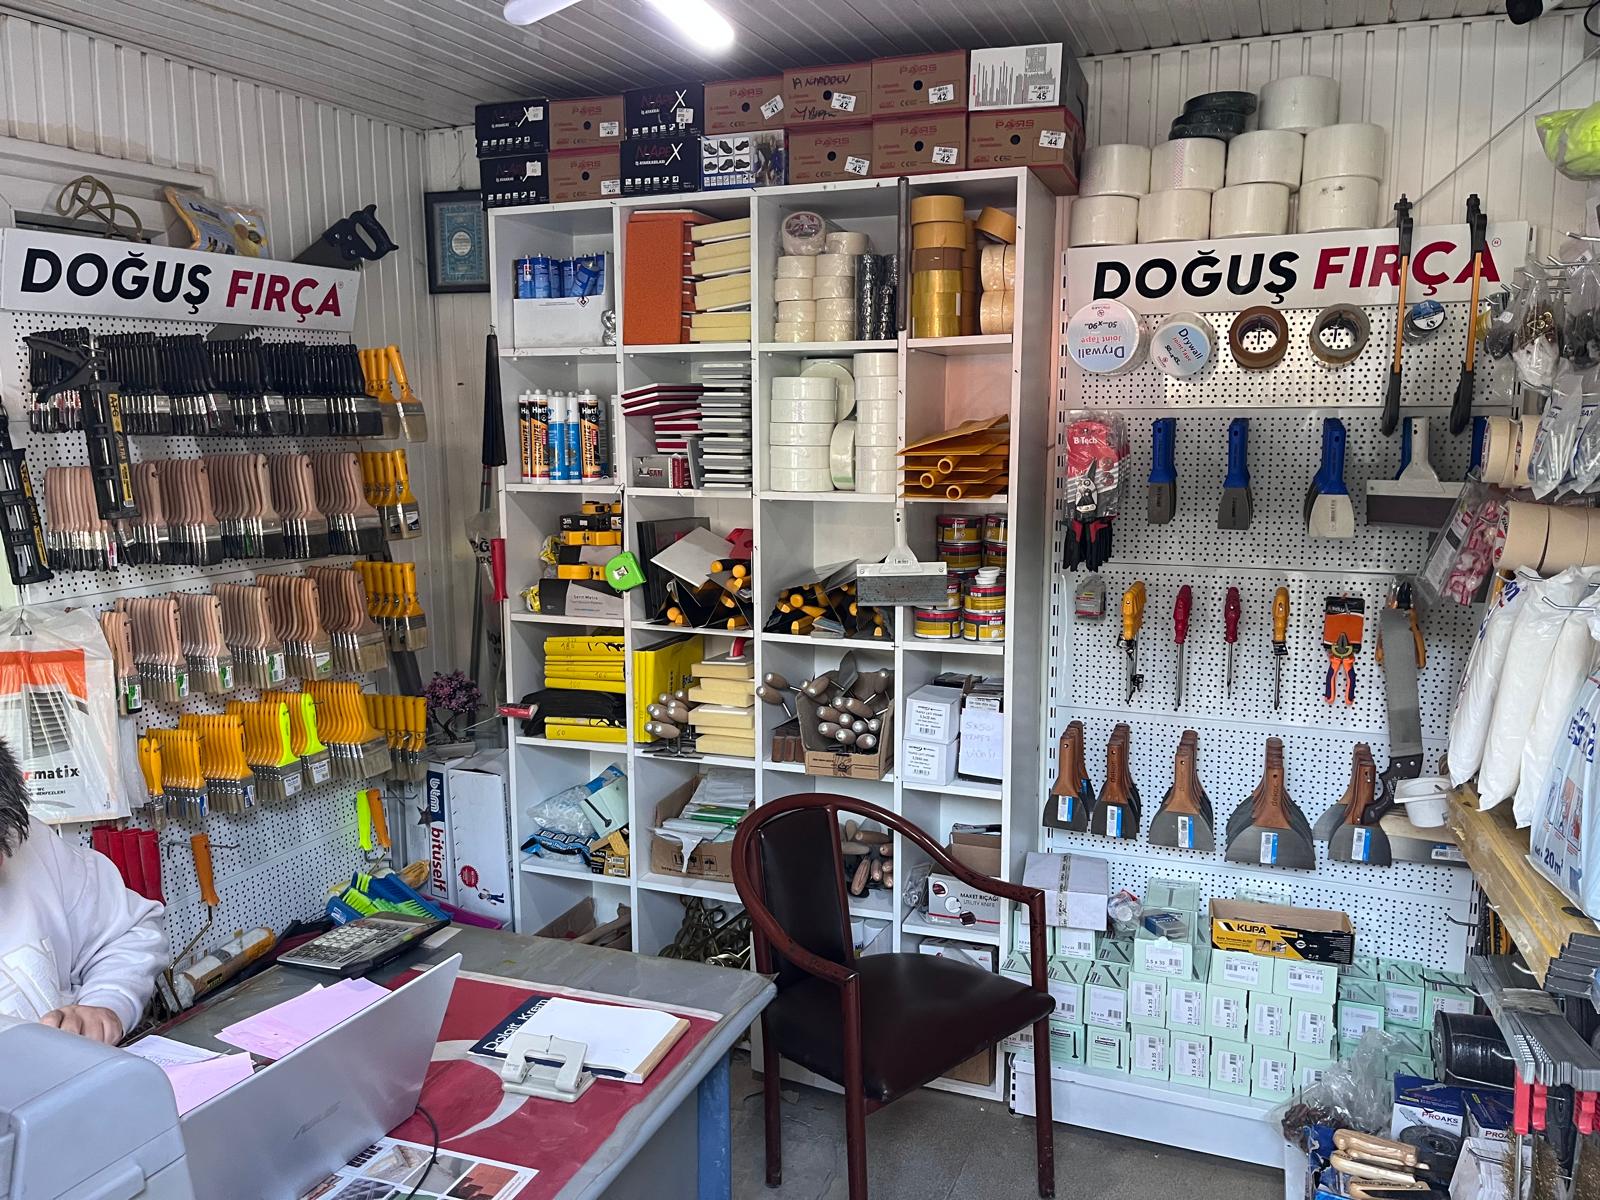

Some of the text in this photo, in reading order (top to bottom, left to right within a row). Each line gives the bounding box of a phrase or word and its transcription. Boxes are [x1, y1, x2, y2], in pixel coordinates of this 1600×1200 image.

[770, 104, 779, 114] 41
[839, 102, 848, 110] 42
[995, 119, 1034, 130] PARS
[1092, 241, 1501, 304] DOĞUŞ FIRÇA
[20, 248, 342, 323] DOĞUŞ FIRÇA
[1102, 335, 1121, 343] Joint
[1178, 328, 1203, 360] Drywall
[1078, 344, 1124, 358] Drywall
[431, 826, 446, 892] bitüself
[1237, 923, 1266, 934] KUPA
[518, 999, 552, 1020] Krem
[1422, 1110, 1458, 1124] PROAKS
